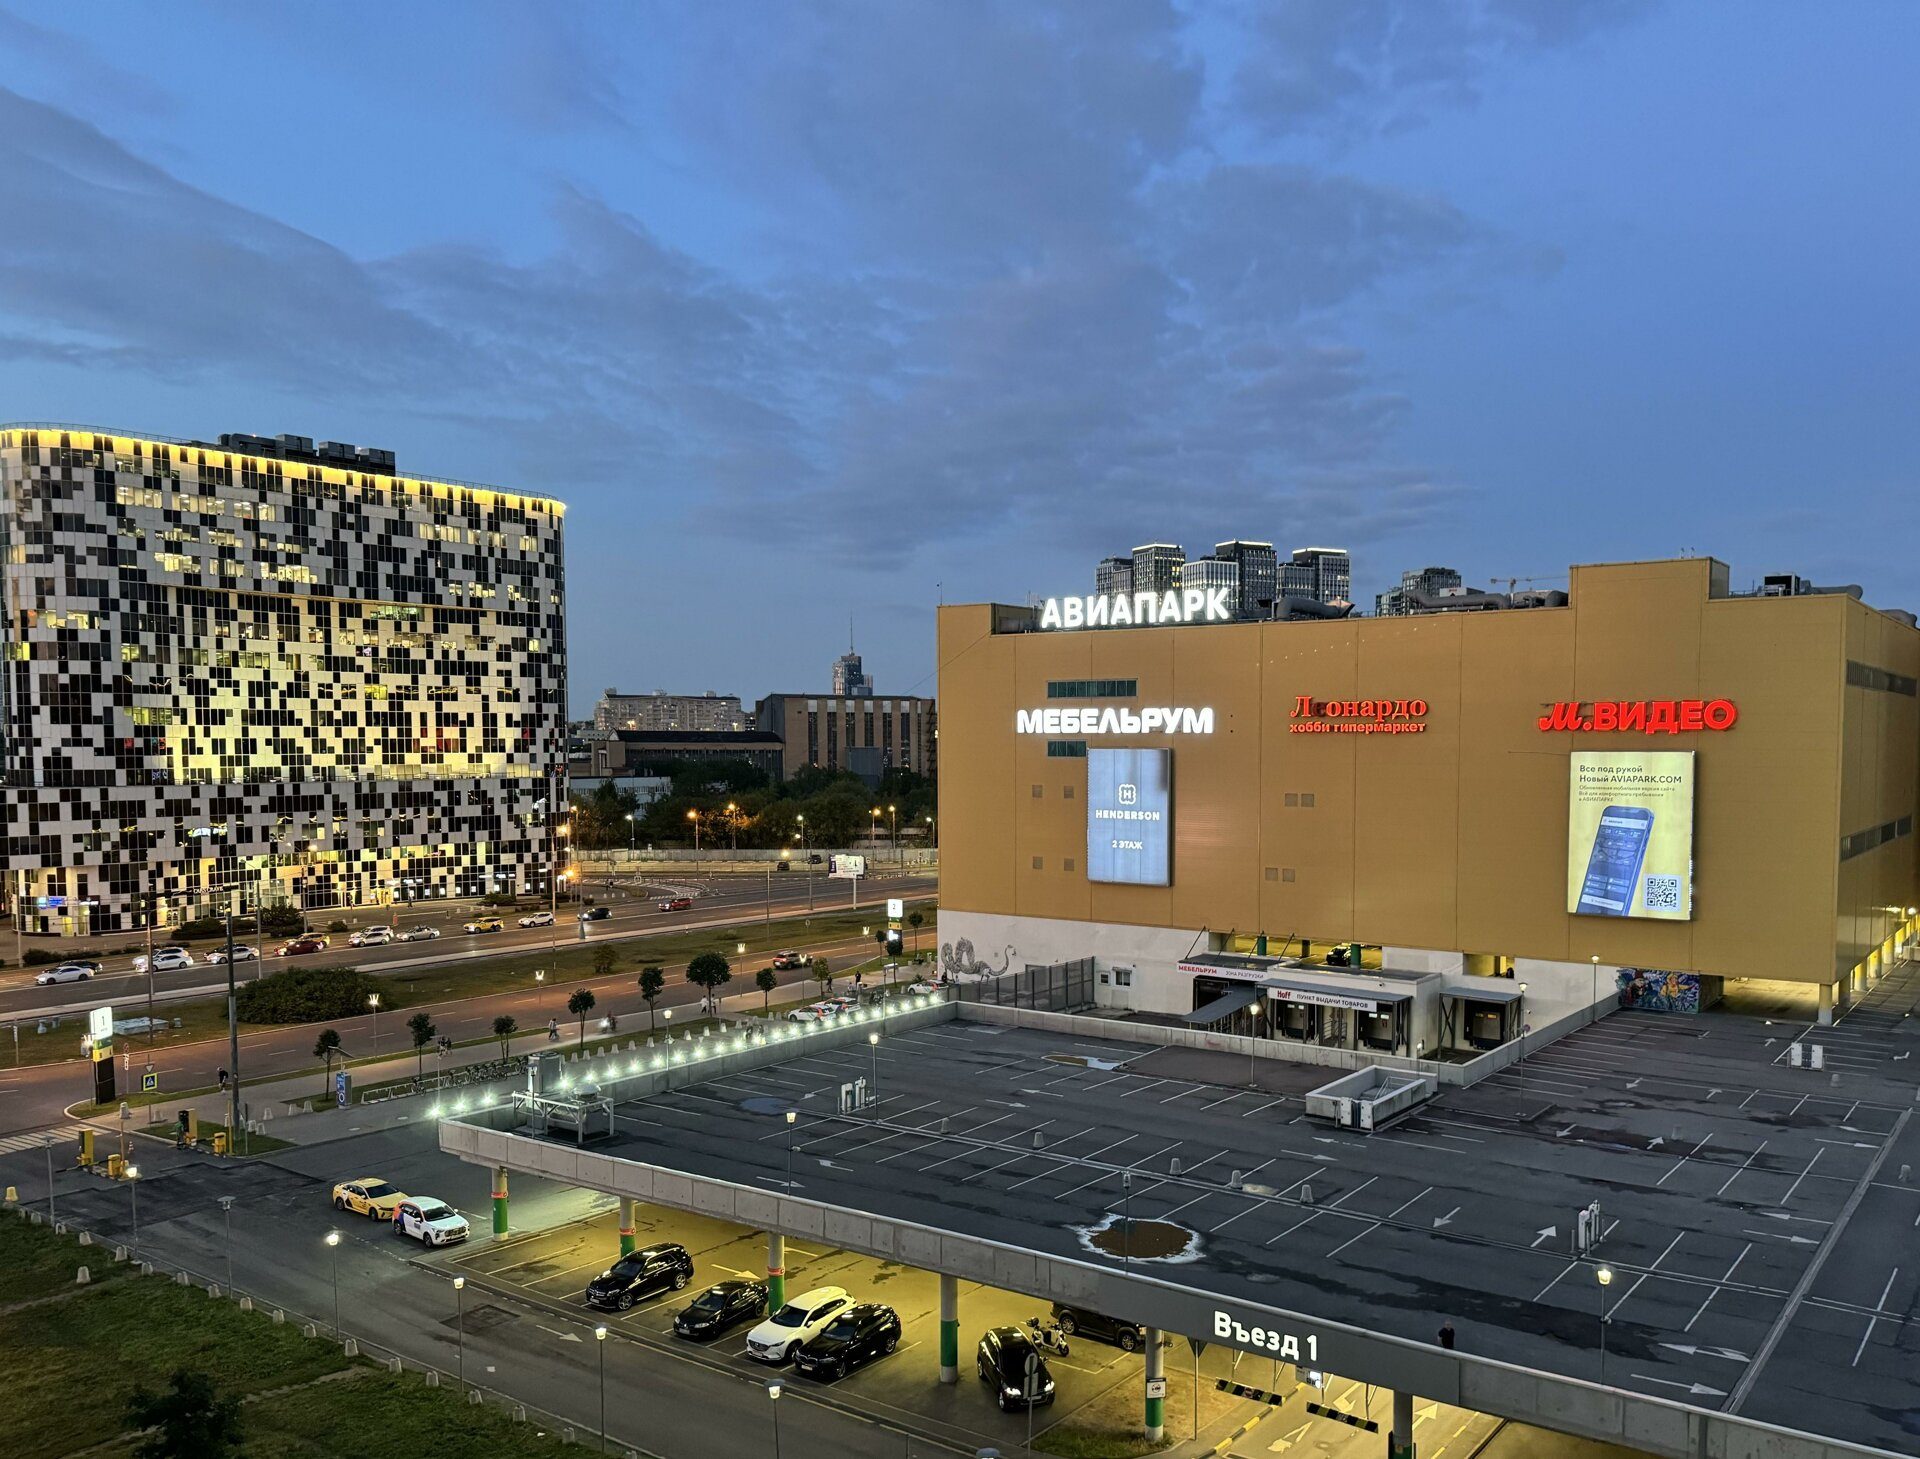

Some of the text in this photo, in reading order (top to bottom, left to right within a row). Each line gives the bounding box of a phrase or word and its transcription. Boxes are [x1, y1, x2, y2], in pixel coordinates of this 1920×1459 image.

[1041, 587, 1230, 629] АВИАПАРК
[1290, 696, 1427, 722] Леонардо
[1016, 707, 1214, 734] МЕБЕЛЬРУМ
[1538, 700, 1738, 735] М.ВИДЕО
[1289, 721, 1426, 735] хобби гипермаркет
[1579, 764, 1596, 773] Все
[1616, 765, 1643, 775] рукой
[1579, 775, 1682, 784] Новый AVIAPARK.COM
[1095, 809, 1160, 821] HENDERSON
[1112, 840, 1143, 850] 2 ЭТАЖ
[1178, 965, 1217, 975] МЕБЕЛЬРУМ
[1277, 990, 1291, 1000] Hoff
[1296, 993, 1369, 1009] ПУНКТ ВЫДАЧИ ТОВАРОВ
[1214, 1310, 1317, 1361] Въезд 1
